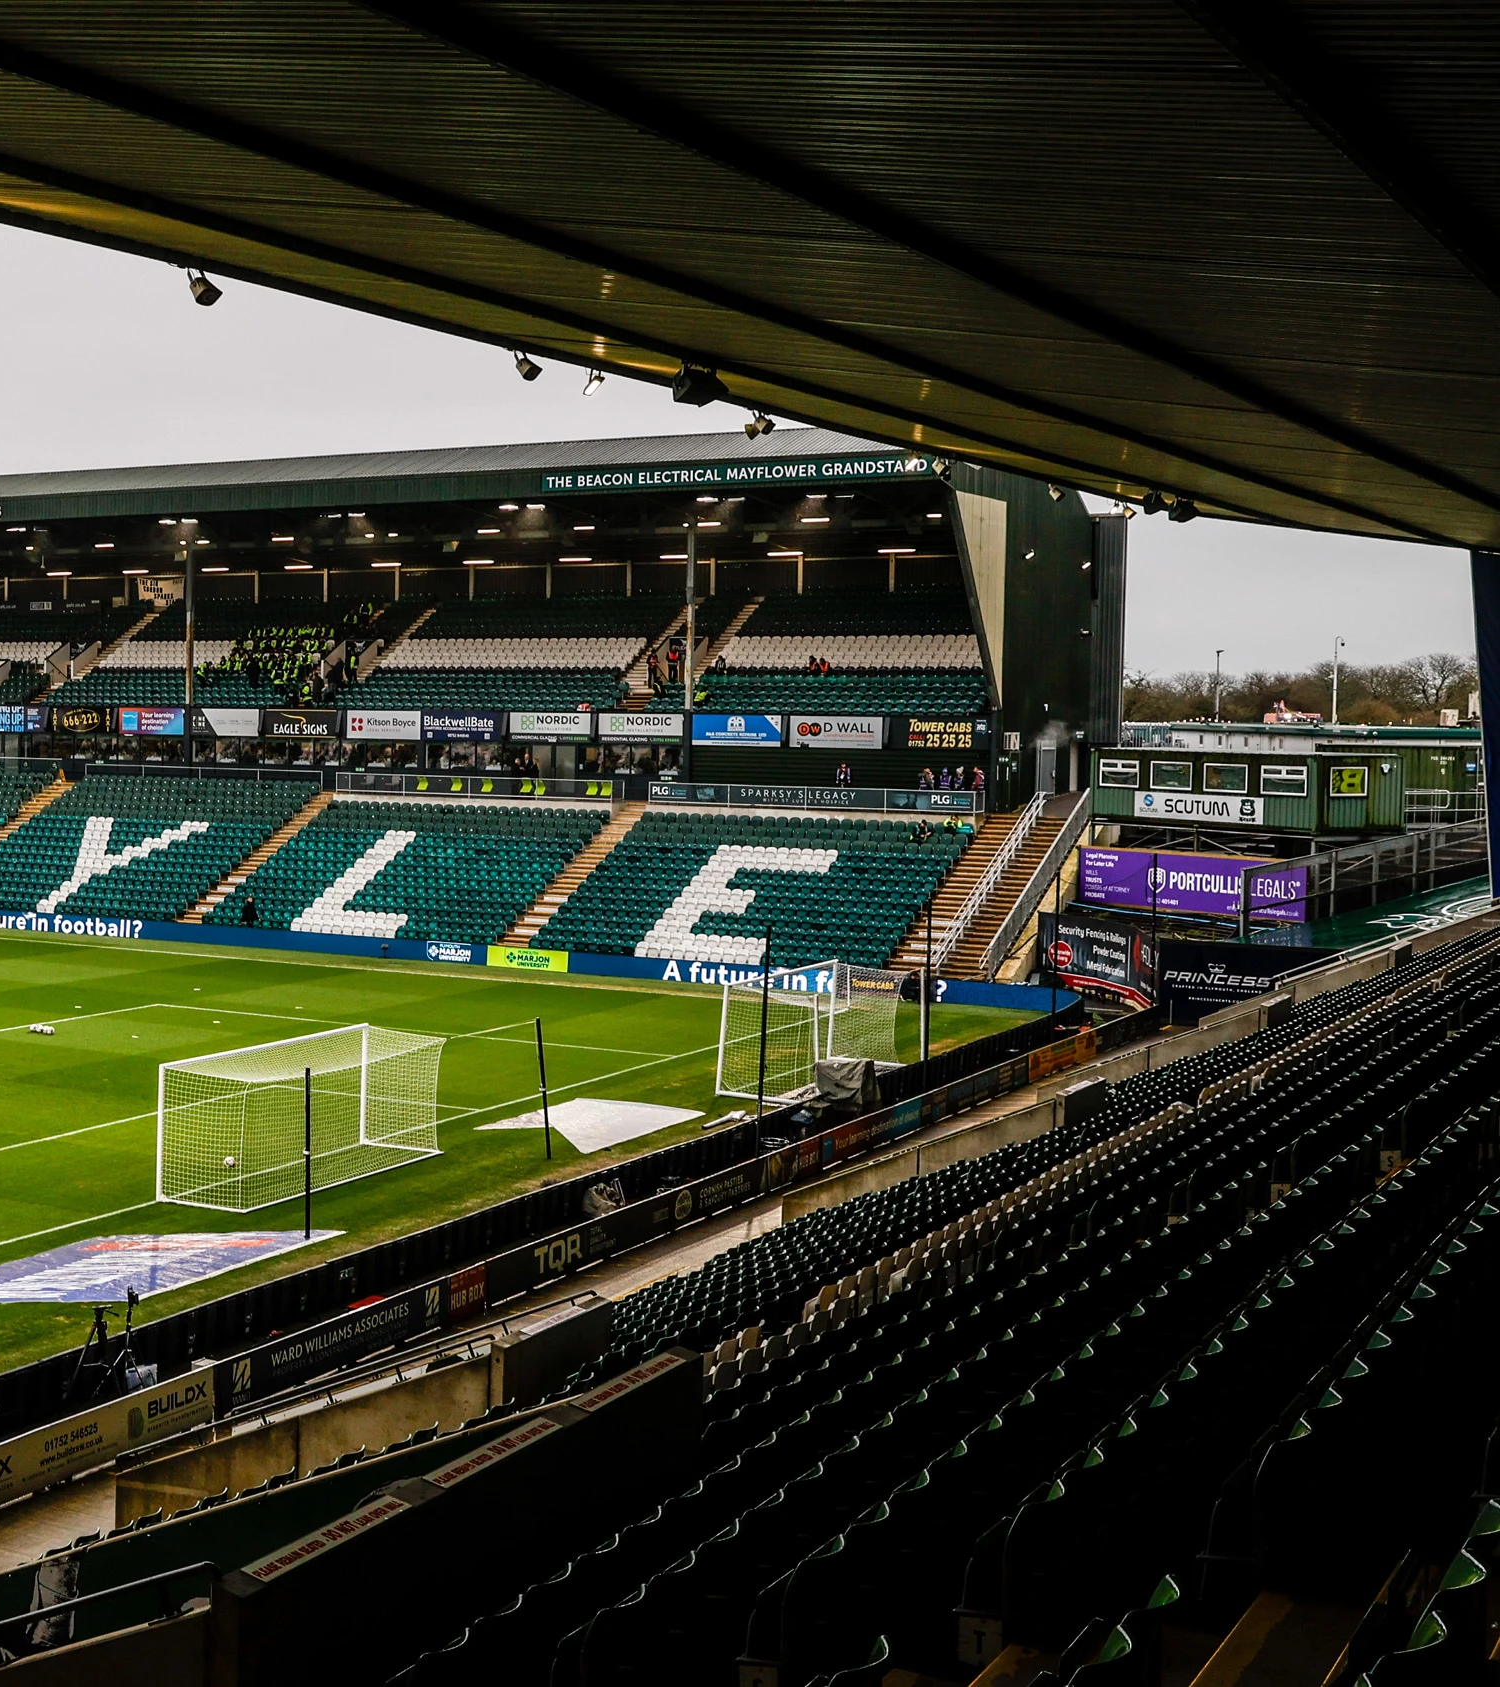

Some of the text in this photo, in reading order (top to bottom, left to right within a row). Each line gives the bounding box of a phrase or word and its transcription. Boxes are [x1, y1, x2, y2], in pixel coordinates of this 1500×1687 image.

[546, 476, 573, 489] THE
[576, 473, 633, 488] BEACON
[638, 468, 722, 486] ELECTRICAL
[726, 464, 817, 481] MAYFLOWER
[11, 713, 25, 725] UP!
[63, 713, 99, 727] 666-222
[153, 711, 175, 720] learning
[423, 715, 494, 728] BlackwellBate
[536, 715, 580, 725] NORDIC
[626, 716, 672, 726] NORDIC
[273, 724, 328, 735] EAGLE SIGNS
[366, 718, 416, 728] Kitson Boyce
[823, 722, 874, 733] D WALL
[908, 718, 973, 733] TOWER CABS
[926, 733, 972, 748] 25 25 25
[651, 786, 669, 795] PLG
[740, 788, 856, 800] SPARKSY'S LEGACY
[930, 794, 951, 805] PLG
[1164, 798, 1231, 817] SCUTUM
[1085, 852, 1119, 862] Legal Planning
[1085, 876, 1103, 884] TRUSTS
[1084, 891, 1106, 899] PROBATE
[31, 912, 49, 932] in
[52, 914, 143, 939] football?
[1058, 924, 1085, 939] Security
[1085, 928, 1106, 942] Fencing
[1109, 933, 1127, 945] Railings
[438, 947, 472, 957] MARJON
[438, 954, 471, 963] UNIVERSITY
[517, 954, 550, 964] MARJON
[1092, 945, 1110, 957] Powder
[1109, 948, 1126, 963] Coating
[662, 960, 682, 982] A
[1086, 960, 1126, 978] Metal Fabrication
[1164, 970, 1271, 988] PRINCESS
[723, 1174, 744, 1190] PASTIES
[533, 1233, 583, 1274] TQR
[450, 1282, 485, 1311] HUB BOX
[271, 1302, 410, 1367] WARD WILLIAMS ASSOCIATES
[147, 1381, 208, 1419] BUILDX
[44, 1423, 99, 1452] 01752 546525
[252, 1562, 279, 1579] PLEASE
[275, 1550, 305, 1569] REMAIN
[298, 1540, 326, 1555] SEATED
[321, 1529, 343, 1541] DO
[334, 1520, 359, 1534] NOT
[368, 1507, 390, 1519] OVER
